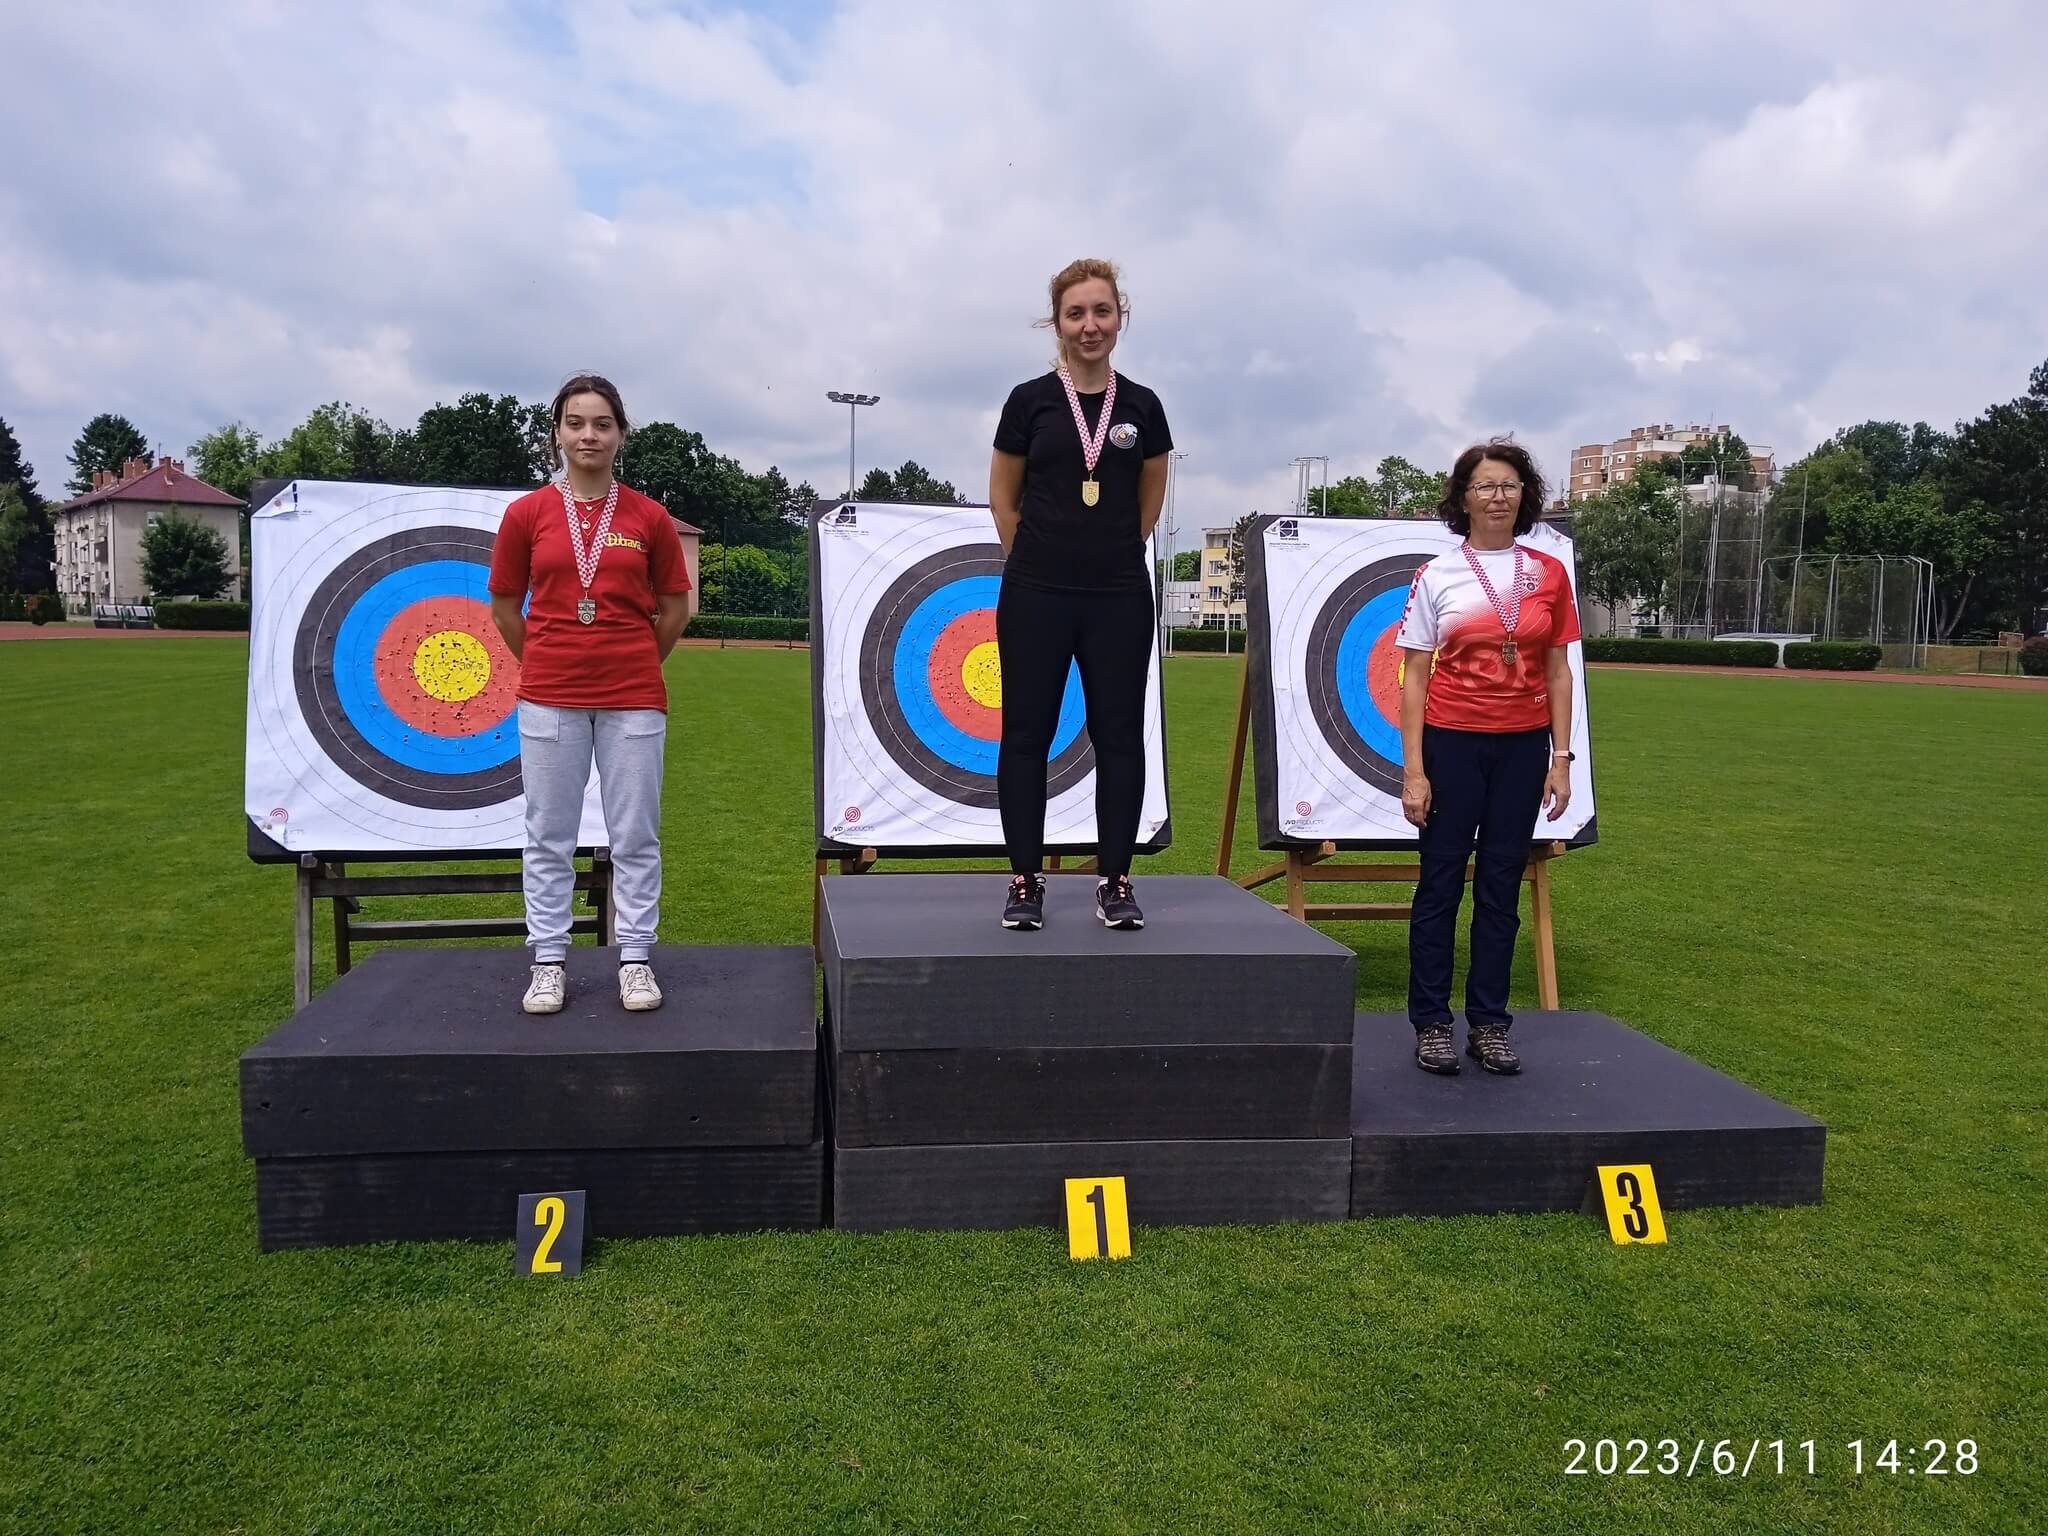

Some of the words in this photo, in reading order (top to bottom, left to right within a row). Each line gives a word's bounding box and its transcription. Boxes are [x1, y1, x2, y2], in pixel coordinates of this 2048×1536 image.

[531, 1197, 565, 1274] 2
[1086, 1185, 1108, 1257] 1
[1616, 1172, 1649, 1239] 3
